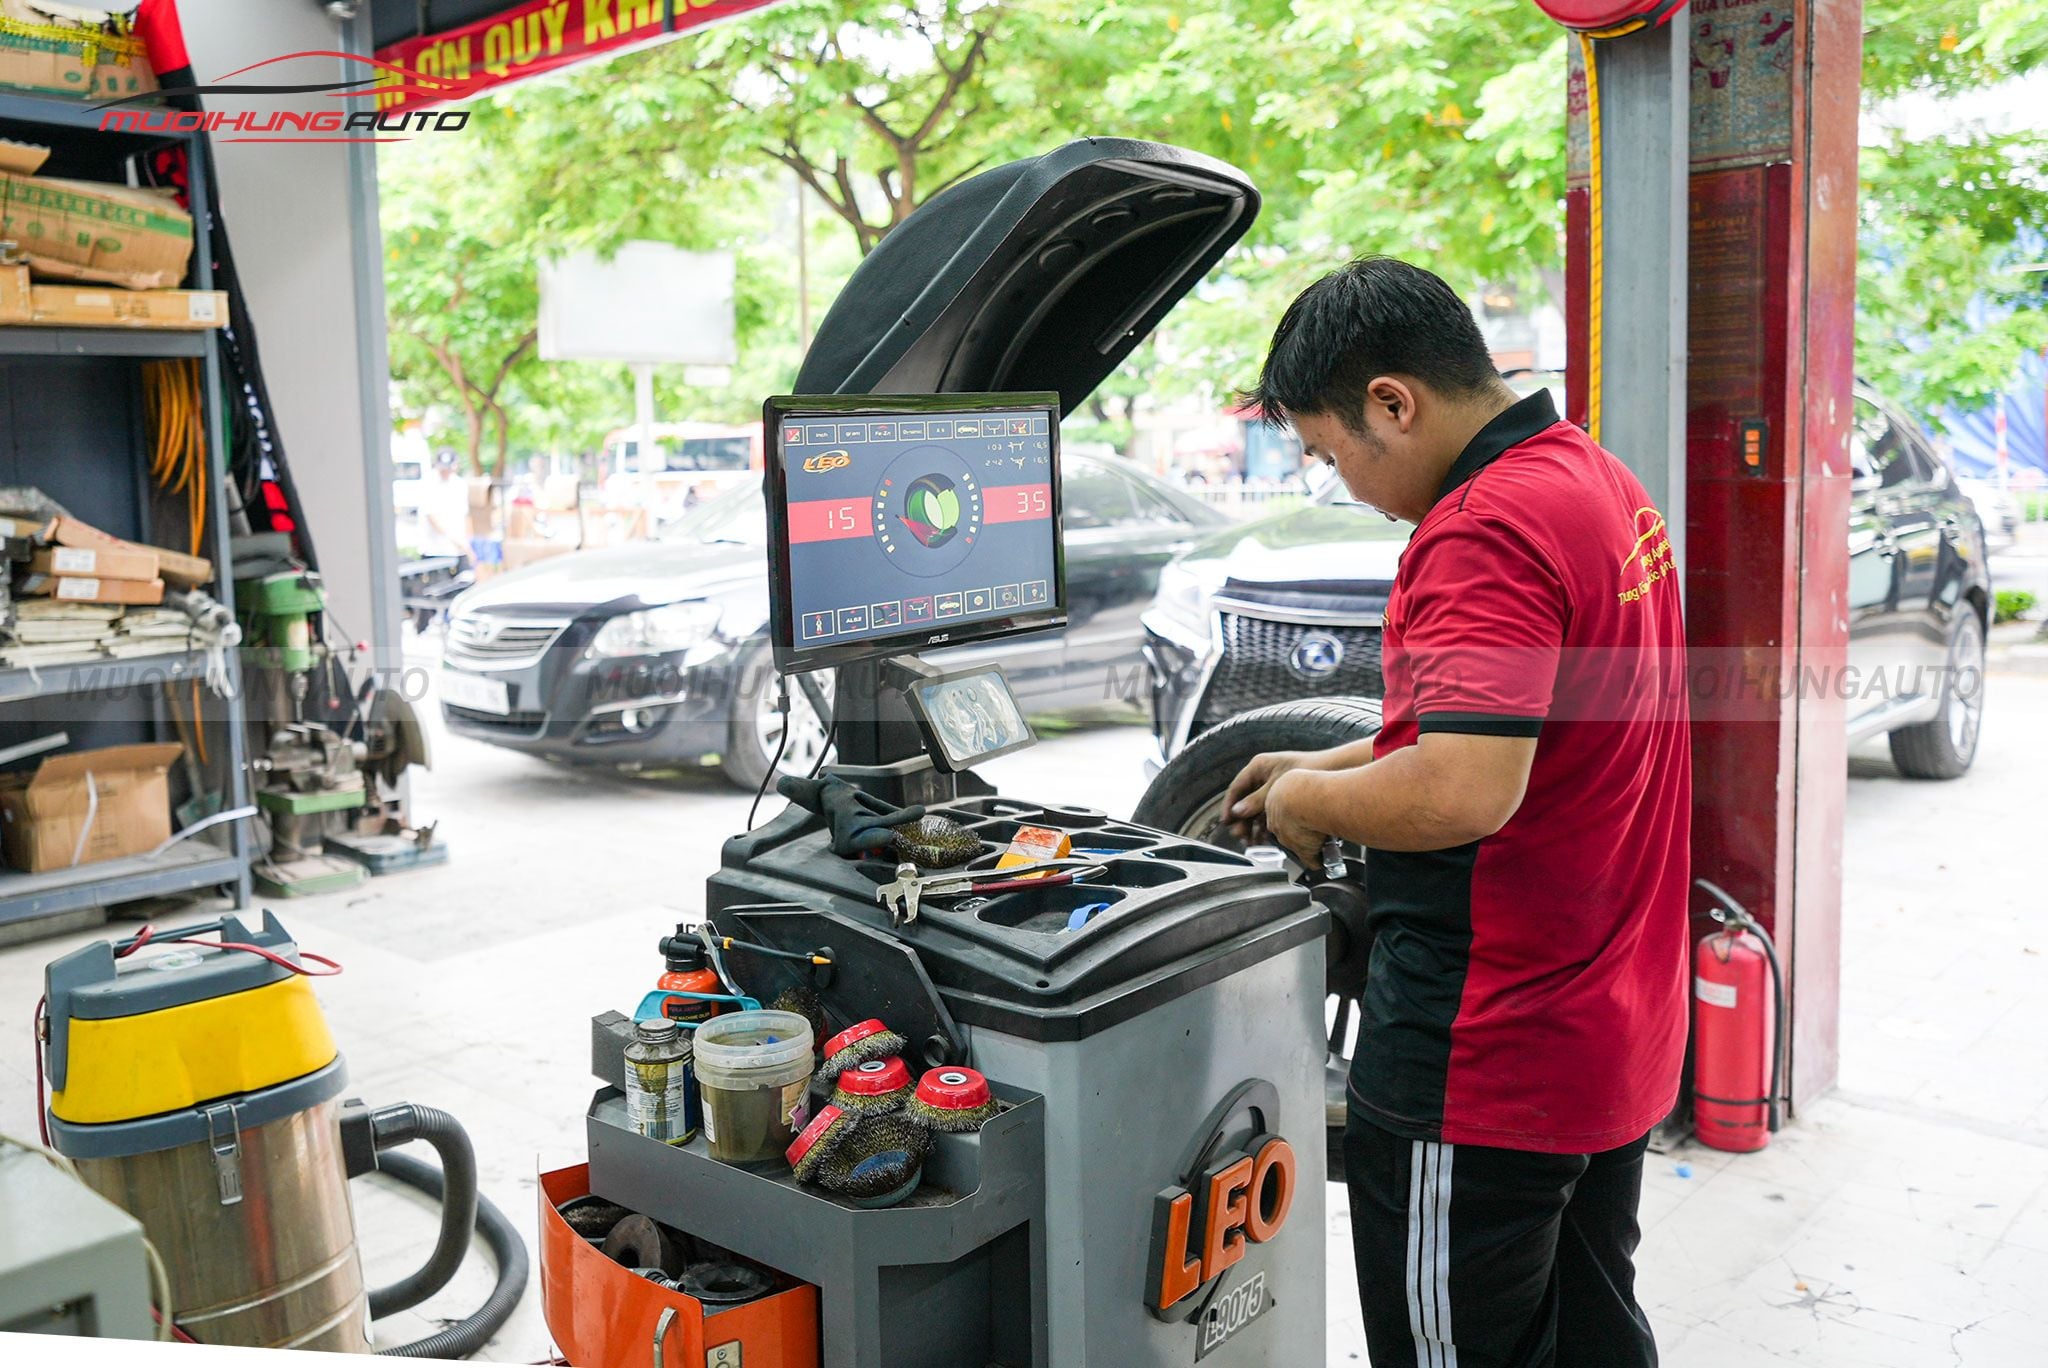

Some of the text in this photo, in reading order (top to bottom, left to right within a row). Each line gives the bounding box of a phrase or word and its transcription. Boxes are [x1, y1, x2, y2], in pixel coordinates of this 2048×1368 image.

[802, 454, 851, 471] LEO
[1017, 490, 1047, 514] 35
[827, 506, 856, 531] 15
[927, 633, 949, 645] ASUS
[1157, 1136, 1297, 1311] LEO
